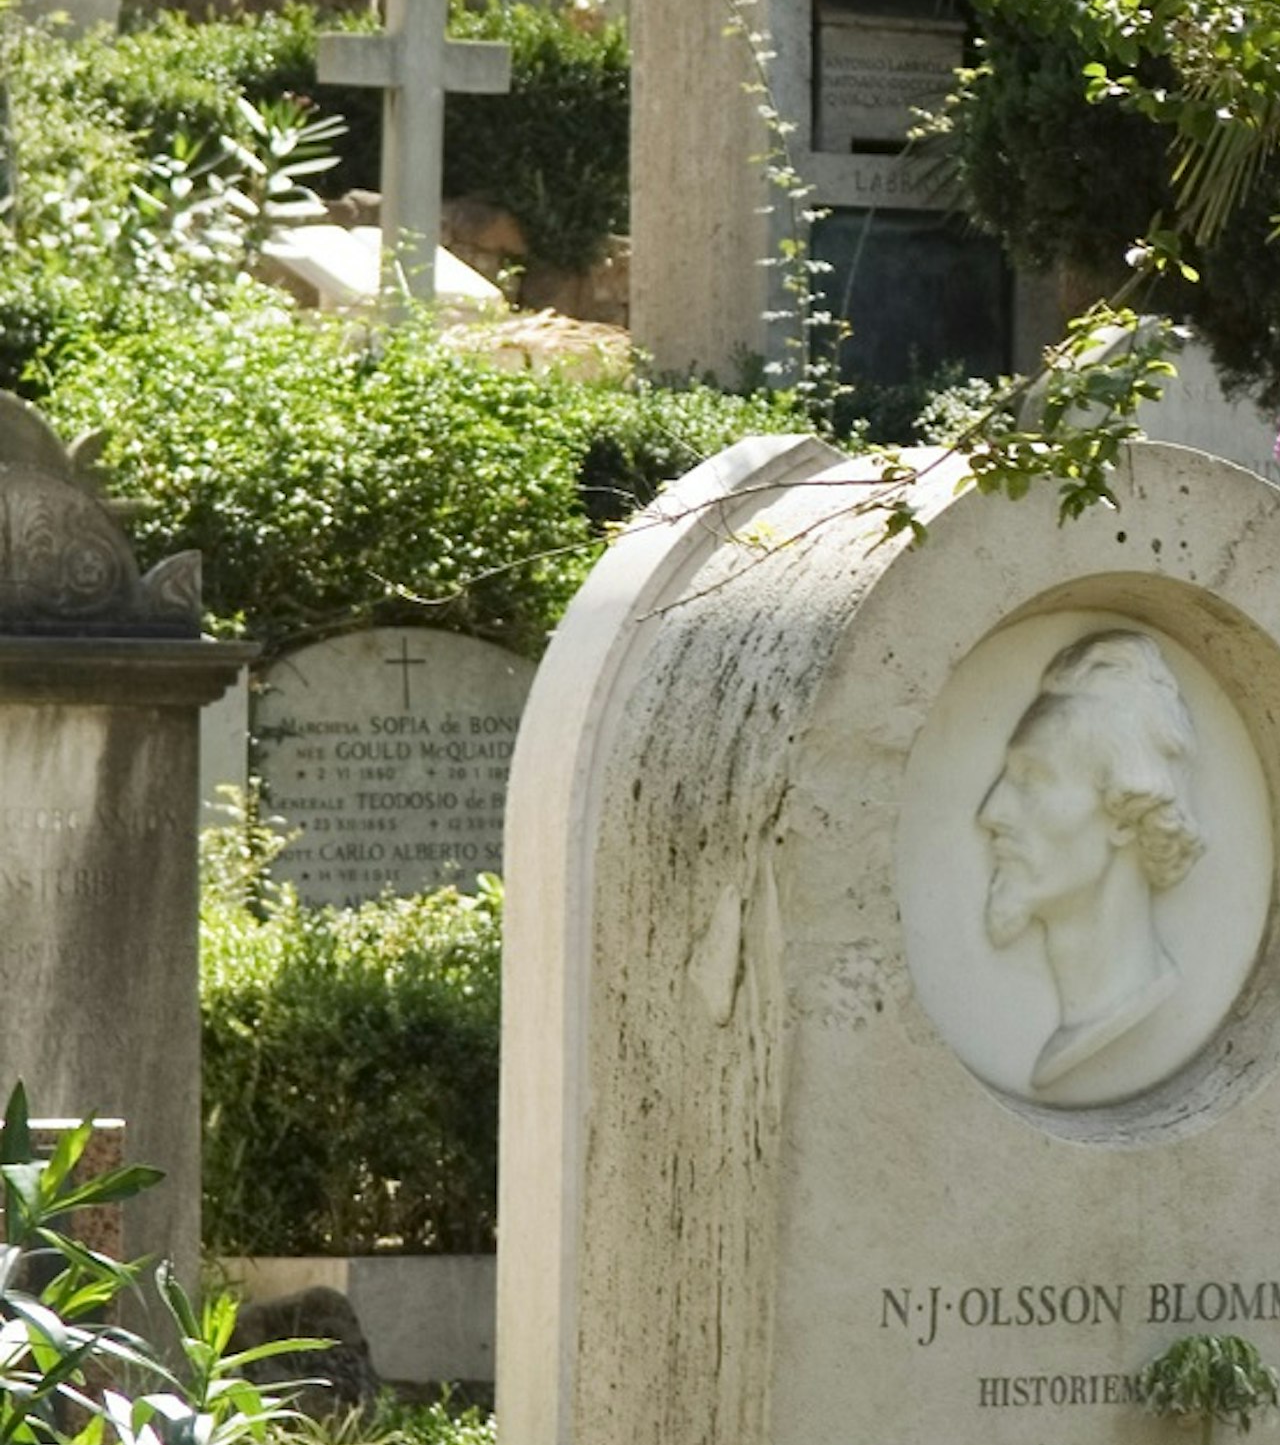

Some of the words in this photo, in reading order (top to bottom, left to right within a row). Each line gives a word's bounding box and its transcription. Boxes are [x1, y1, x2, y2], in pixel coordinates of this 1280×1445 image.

[370, 716, 431, 736] SOFIA
[440, 711, 460, 735] de
[335, 741, 412, 761] GOULD
[419, 741, 514, 764] McQUAID
[356, 792, 459, 810] TEODOSIO
[465, 787, 486, 810] de
[318, 842, 386, 862] CARLO
[393, 840, 479, 861] ALBERTO
